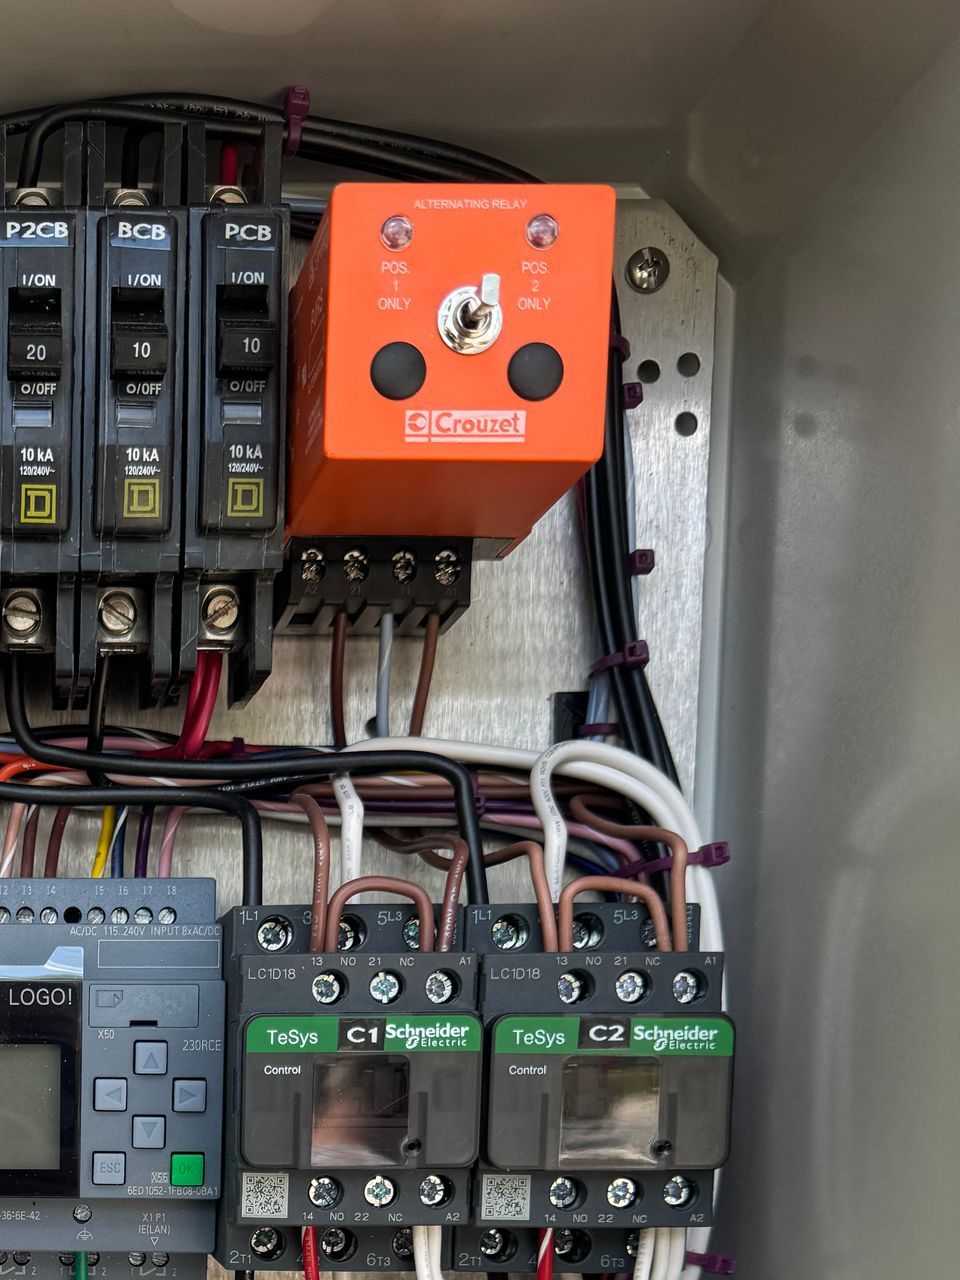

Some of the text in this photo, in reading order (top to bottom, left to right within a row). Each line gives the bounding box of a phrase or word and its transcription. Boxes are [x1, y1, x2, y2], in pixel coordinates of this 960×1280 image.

[414, 199, 528, 209] ALTERNATING RELAY
[6, 221, 69, 239] P2CB
[118, 222, 166, 241] BCB
[225, 223, 272, 242] PCB
[381, 262, 411, 274] POS.
[531, 280, 540, 292] 2
[378, 298, 411, 310] ONLY
[518, 298, 551, 310] ONLY
[132, 342, 151, 358] 10
[242, 337, 261, 354] 10
[26, 344, 47, 361] 20
[435, 412, 520, 433] Crouzet
[20, 447, 54, 462] 10 kA
[126, 446, 159, 462] 10 kA
[229, 444, 263, 459] 10 kA
[70, 926, 97, 937] AC/DC
[150, 926, 180, 936] INPUT
[311, 957, 323, 966] 13
[368, 957, 381, 966] 21
[399, 957, 415, 967] NC
[459, 957, 471, 966] A1
[556, 956, 568, 966] 13
[614, 956, 627, 966] 21
[645, 957, 661, 967] NC
[704, 956, 717, 966] A1
[248, 968, 296, 980] LC1D18
[490, 968, 540, 980] LC1D18
[9, 988, 73, 1006] LOGO!
[97, 1029, 115, 1040] X50
[346, 1027, 378, 1043] C1
[385, 1022, 469, 1039] Schneider
[589, 1025, 624, 1042] C2
[634, 1025, 718, 1042] Schneider
[266, 1029, 318, 1048] TeSys
[421, 1037, 467, 1047] Electric
[512, 1029, 565, 1048] TeSys
[182, 1040, 222, 1052] 230RCE
[669, 1041, 716, 1050] Electric
[264, 1065, 301, 1075] Control
[509, 1066, 546, 1076] Control
[99, 1161, 121, 1174] ESC
[302, 1212, 314, 1220] 14
[354, 1212, 369, 1221] 22
[388, 1213, 403, 1222] NC
[445, 1212, 460, 1221] A2
[545, 1214, 556, 1222] 14
[598, 1214, 614, 1223] 22
[632, 1214, 647, 1224] NC
[690, 1214, 705, 1223] A2
